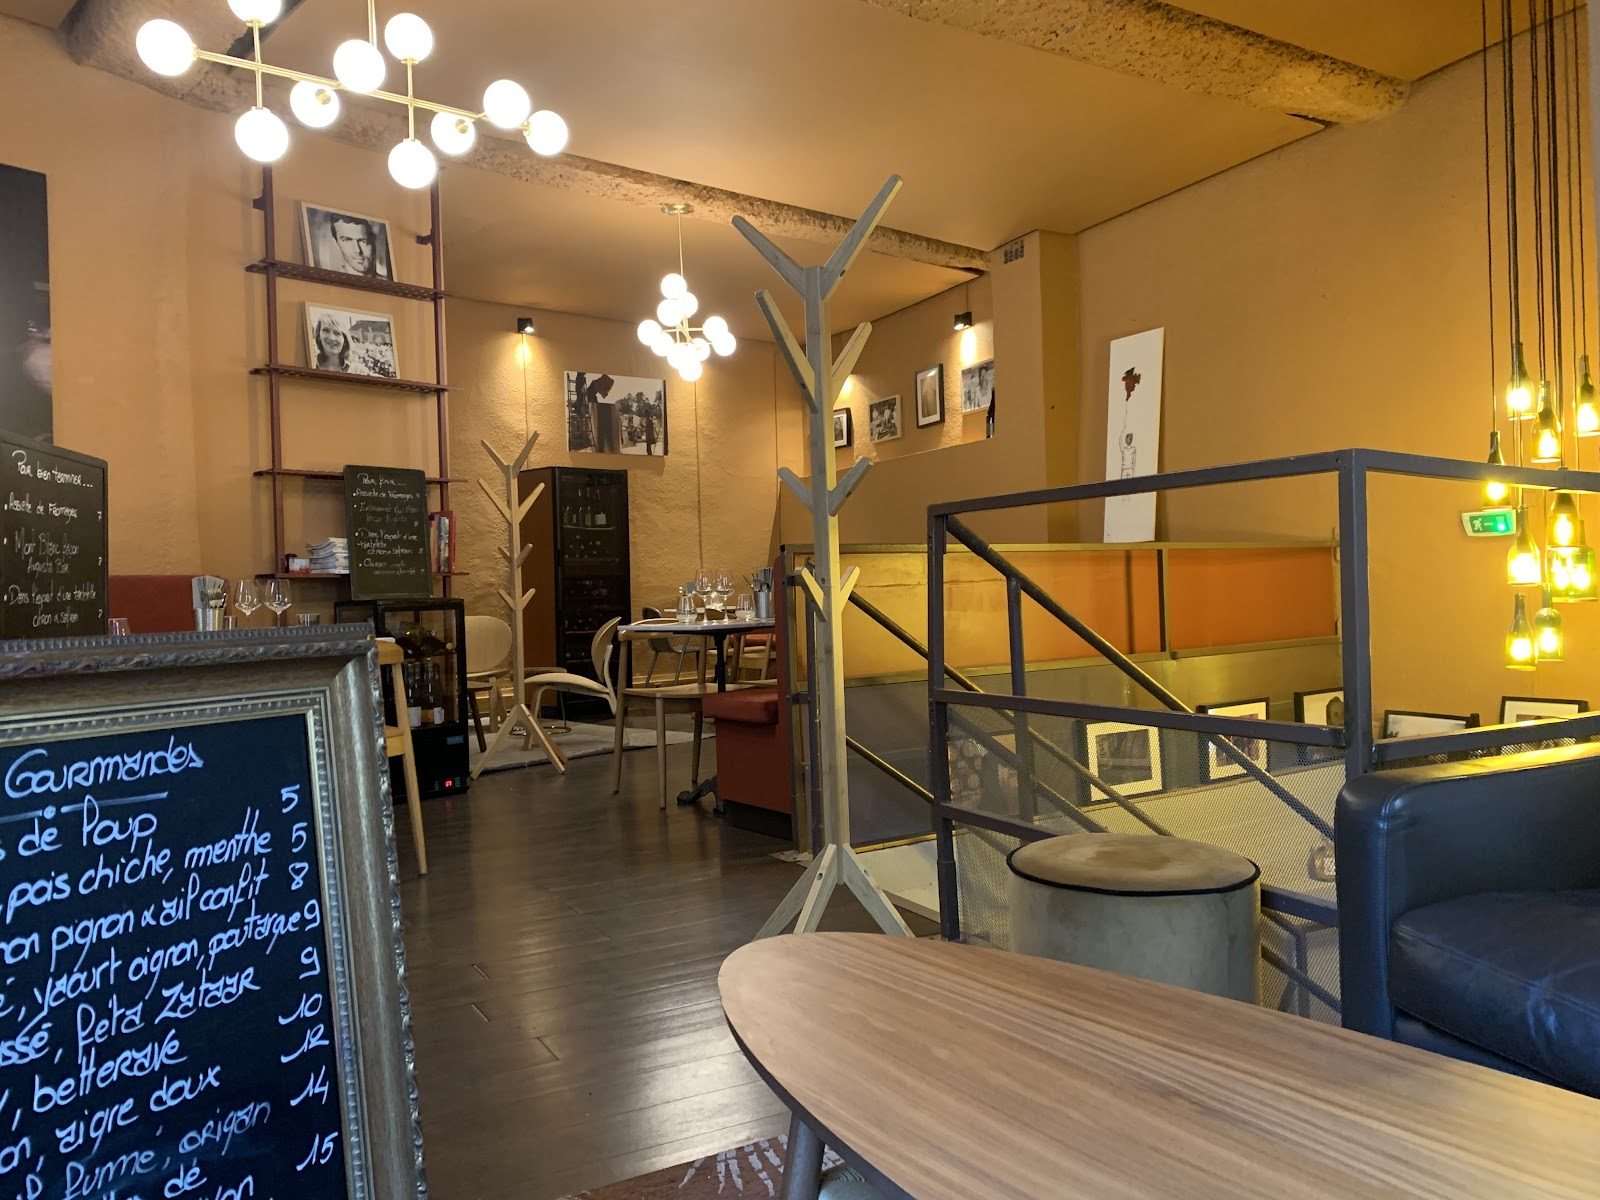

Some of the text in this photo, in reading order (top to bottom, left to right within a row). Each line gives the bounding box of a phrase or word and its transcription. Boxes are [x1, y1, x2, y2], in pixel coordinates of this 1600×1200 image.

[36, 500, 45, 514] de
[18, 818, 62, 856] de
[281, 784, 300, 813] 5
[6, 871, 71, 924] pois
[185, 806, 272, 869] menthe
[292, 822, 308, 852] 5
[200, 857, 269, 922] confit
[289, 862, 309, 890] 8
[304, 899, 320, 931] 9
[299, 947, 320, 979] 9
[33, 1029, 188, 1112] betterave
[278, 993, 322, 1025] 10
[55, 1098, 140, 1155] aigre
[150, 1065, 221, 1112] doux
[281, 1023, 330, 1063] 12
[179, 1102, 271, 1157] origan
[290, 1065, 329, 1107] 14
[296, 1132, 338, 1171] 15
